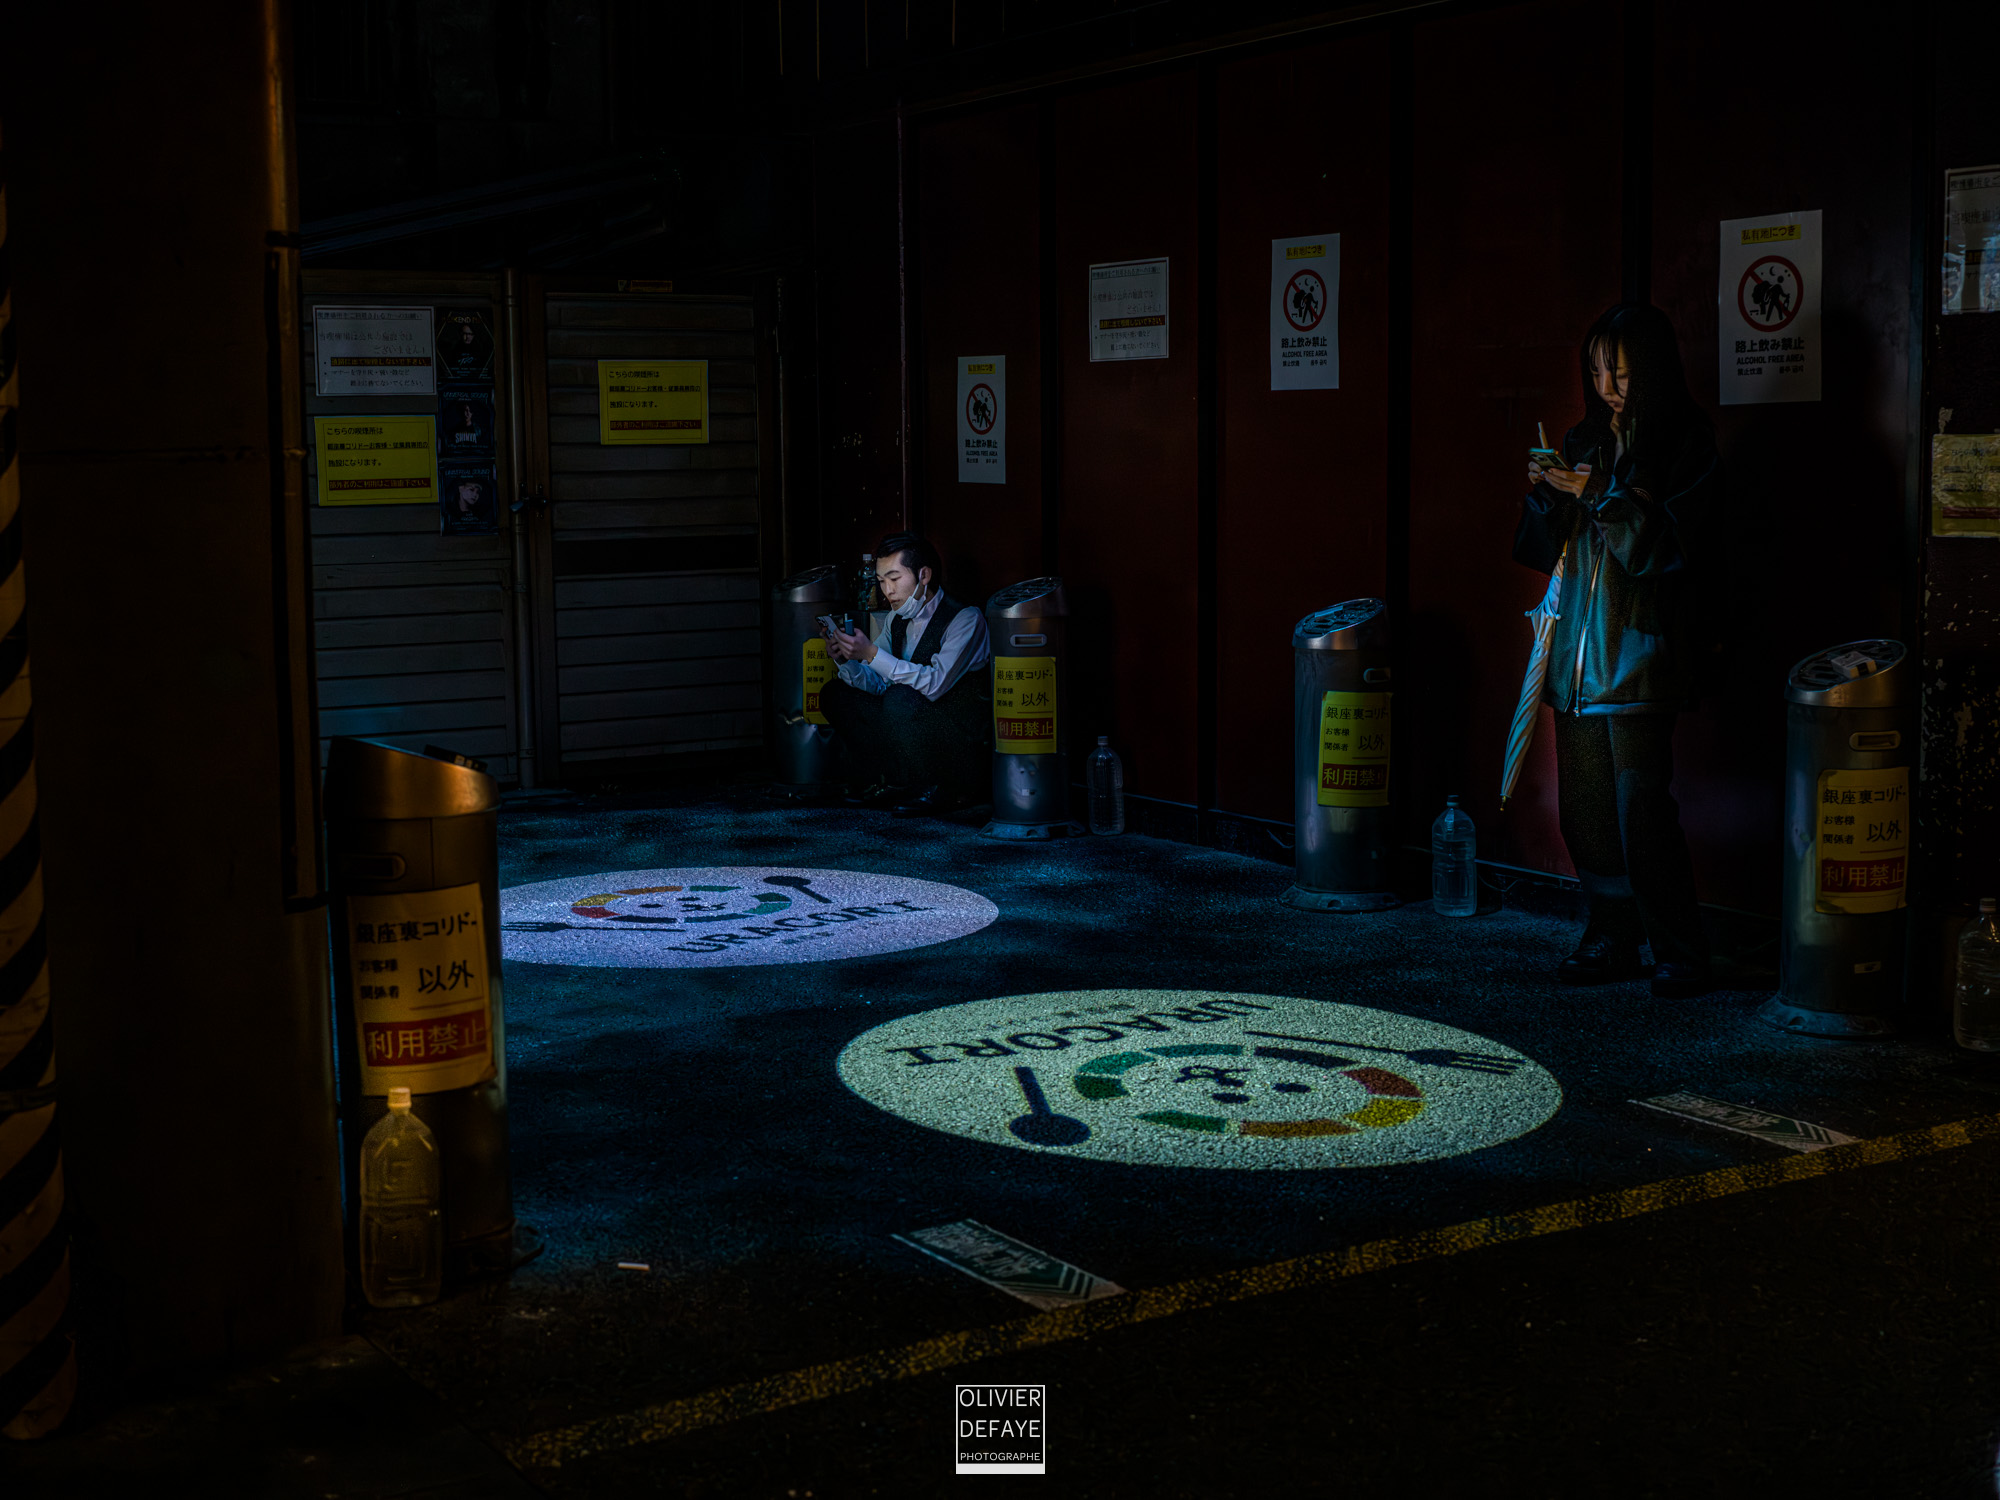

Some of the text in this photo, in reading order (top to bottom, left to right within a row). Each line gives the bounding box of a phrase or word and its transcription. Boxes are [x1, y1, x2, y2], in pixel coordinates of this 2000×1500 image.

[1743, 226, 1795, 241] 私有地につき
[1281, 336, 1328, 348] 路上飲み禁止
[1735, 337, 1805, 353] 路上飲み禁止
[1737, 354, 1804, 364] ALCOHOL FREE AREA
[997, 687, 1013, 695] お客様
[1021, 692, 1049, 707] 以外
[999, 720, 1053, 737] 利用禁止
[1325, 727, 1349, 736] お客様
[1324, 742, 1348, 751] 関係者
[1358, 734, 1385, 751] 以外
[1823, 816, 1855, 825] お客様
[1866, 819, 1902, 842] 以外
[1823, 833, 1855, 844] 関係者
[1824, 862, 1904, 888] 利用禁止
[667, 900, 934, 953] URACORI
[359, 959, 398, 973] お客様
[418, 959, 475, 994] 以外
[360, 985, 399, 1000] 関係者
[367, 1019, 486, 1060] 利用禁止
[886, 999, 1271, 1067] URACORI
